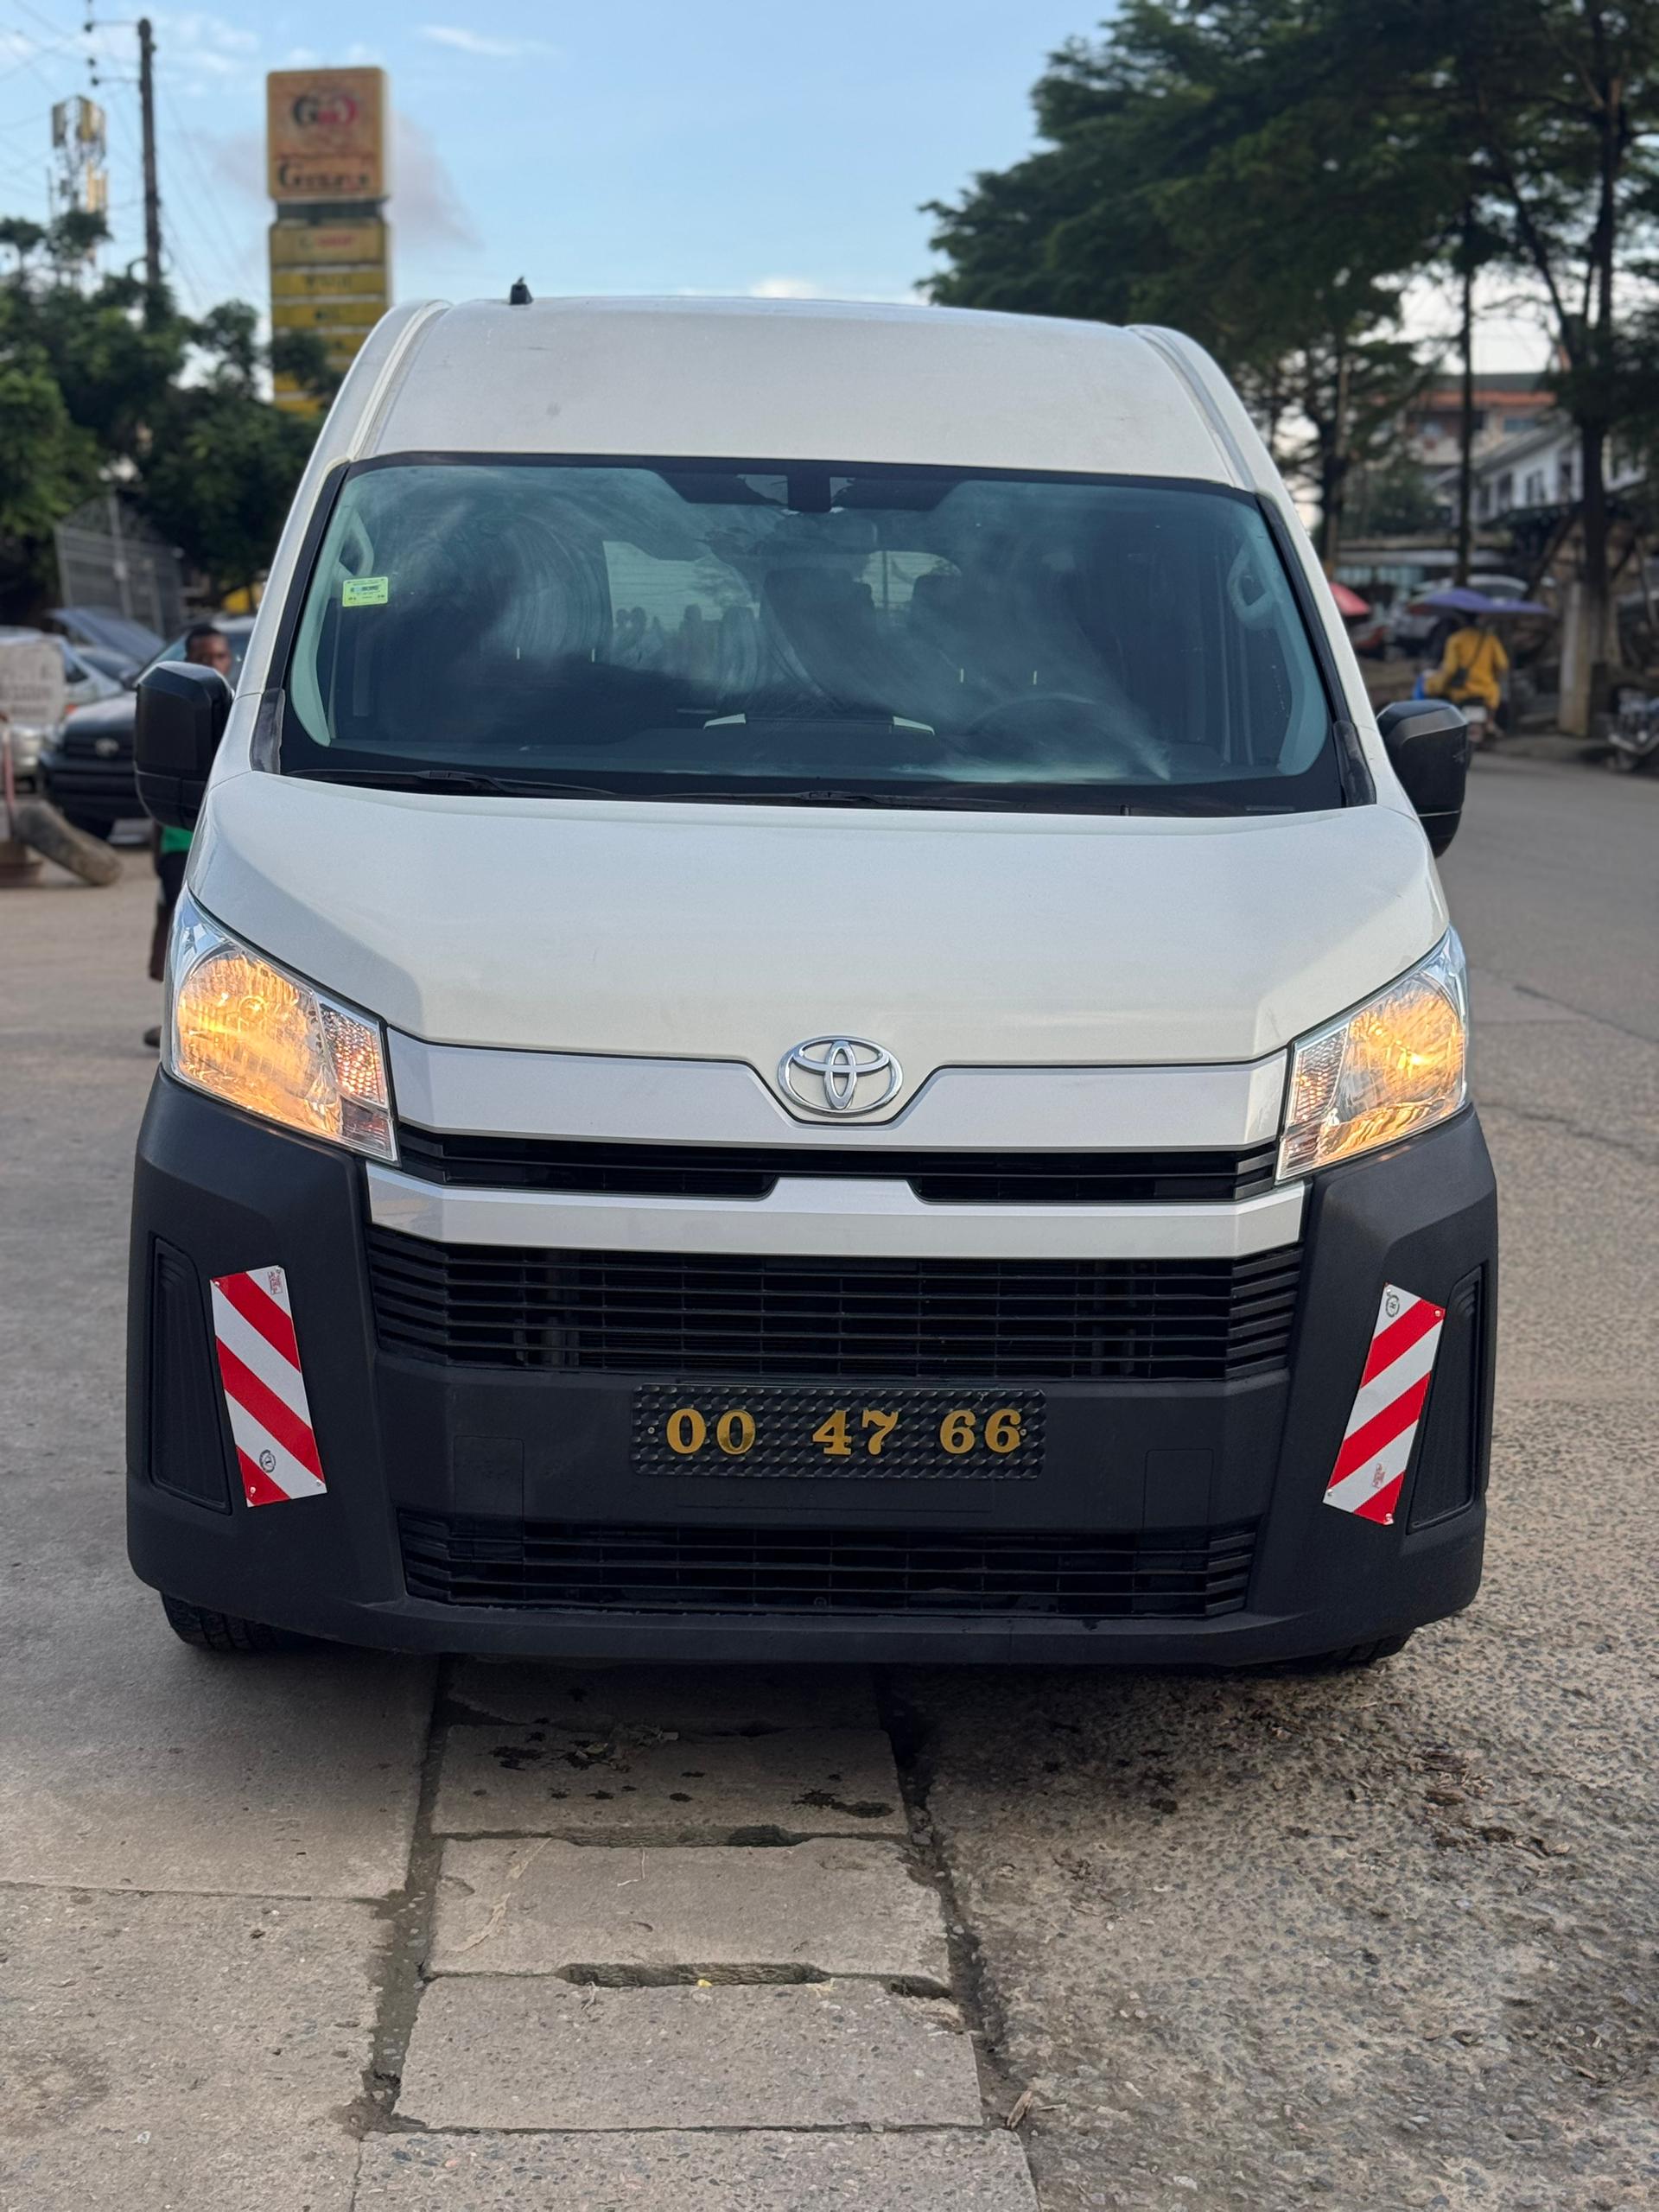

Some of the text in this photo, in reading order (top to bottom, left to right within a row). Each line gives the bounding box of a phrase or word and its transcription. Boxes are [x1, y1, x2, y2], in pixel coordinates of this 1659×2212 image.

[667, 1408, 1021, 1455] 00 47 66
